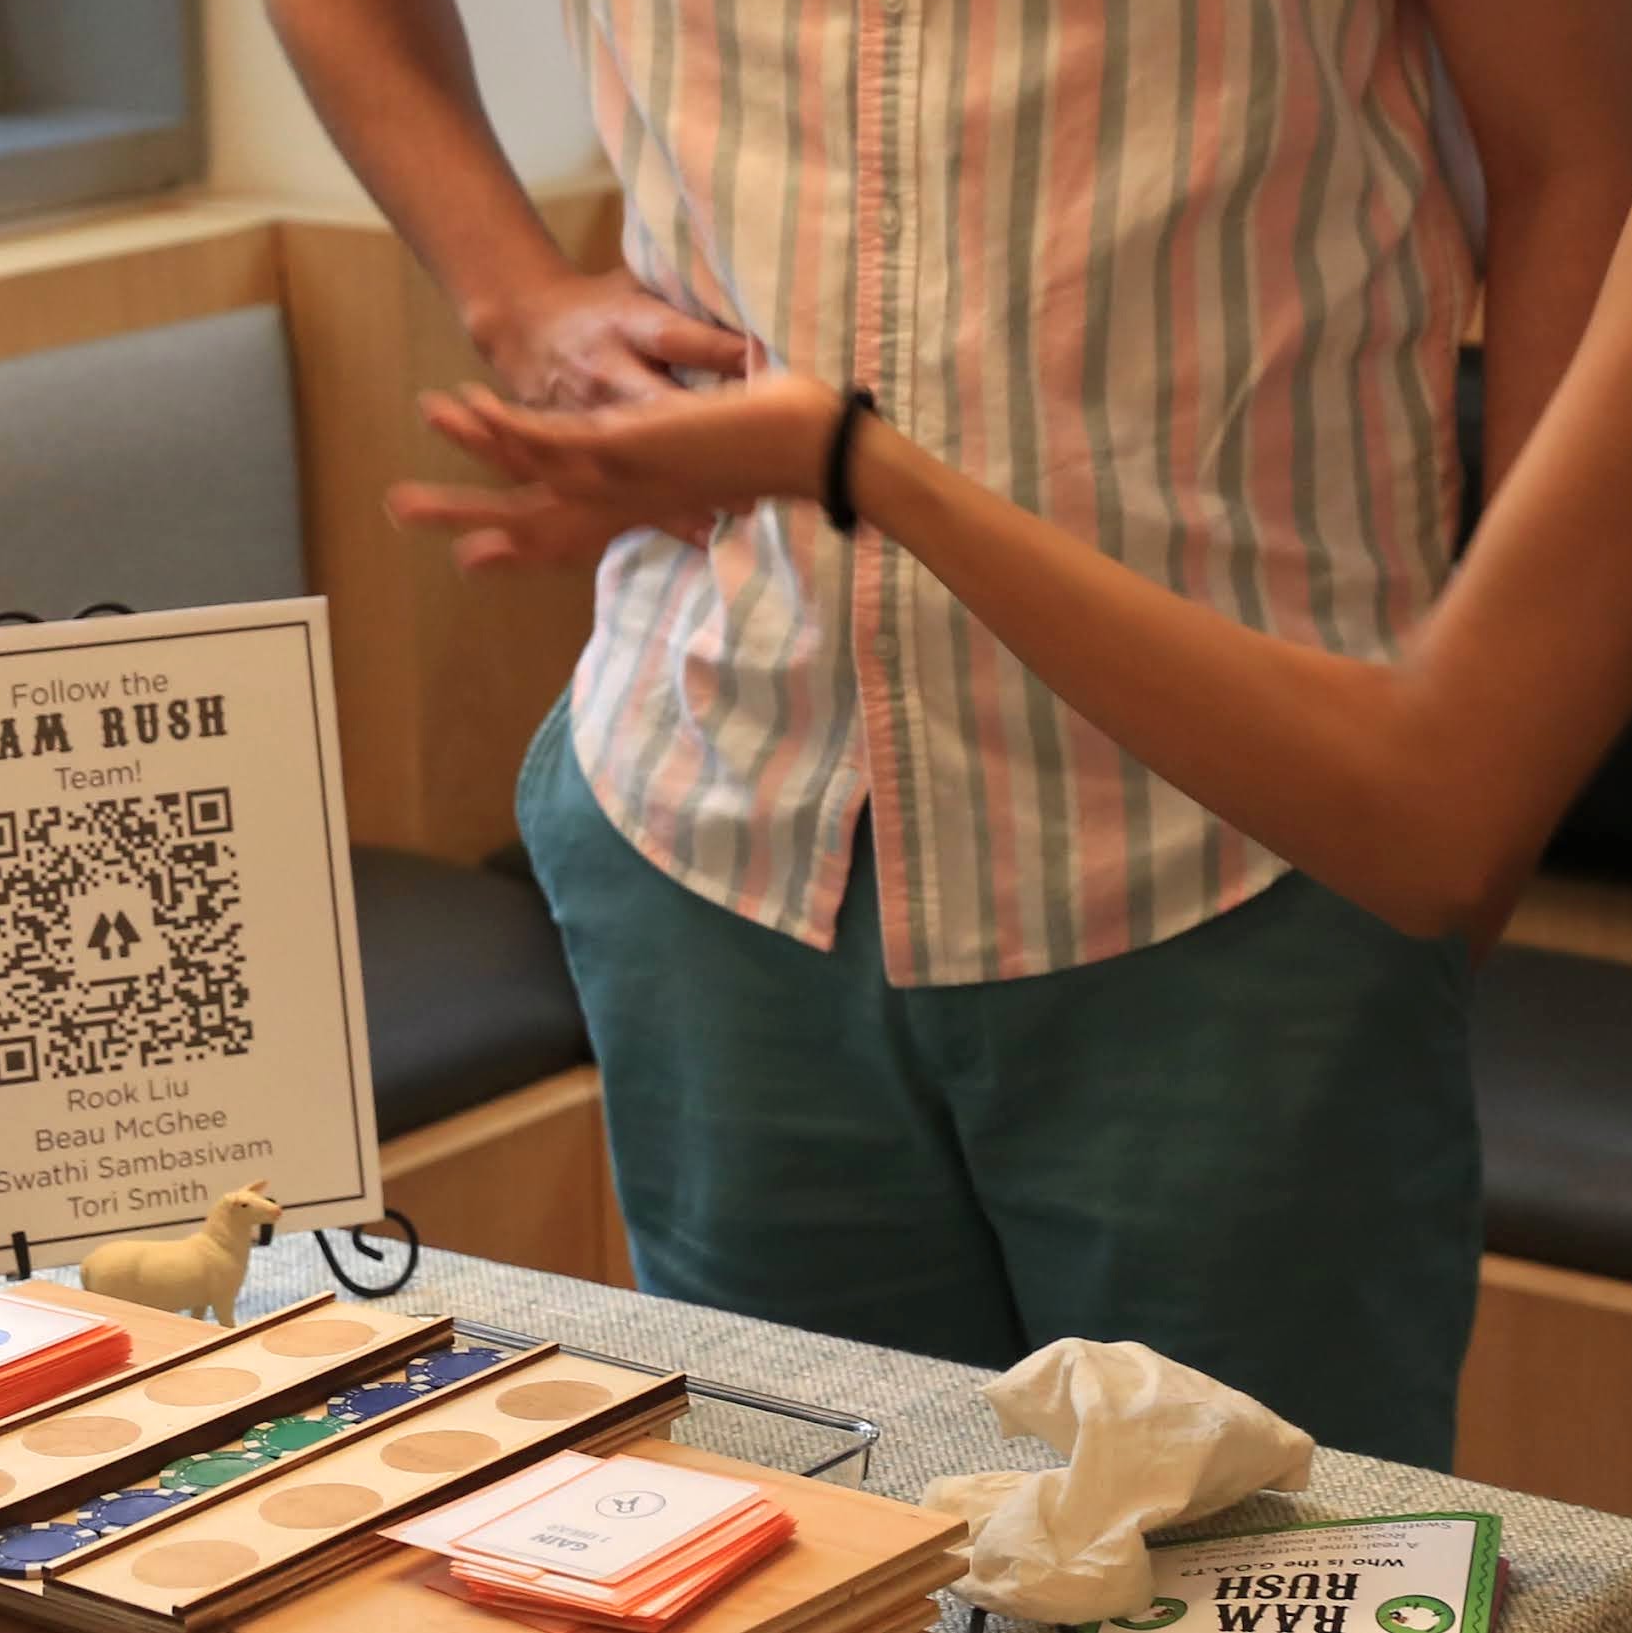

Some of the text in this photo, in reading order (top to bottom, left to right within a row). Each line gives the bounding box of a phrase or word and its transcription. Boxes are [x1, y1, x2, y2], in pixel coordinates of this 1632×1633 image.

[10, 671, 169, 708] Follow the
[99, 694, 228, 749] RUSH
[54, 759, 142, 791] Team!
[67, 1077, 190, 1112] Rook Liu
[35, 1109, 227, 1152] Beau McGhee
[98, 1138, 273, 1179] Sambasivam
[68, 1180, 208, 1219] Tori Smith
[1284, 1559, 1319, 1568] the
[1327, 1558, 1344, 1567] is
[1352, 1558, 1405, 1567] Who
[1212, 1572, 1362, 1600] RUSH
[1214, 1603, 1350, 1633] RAM
